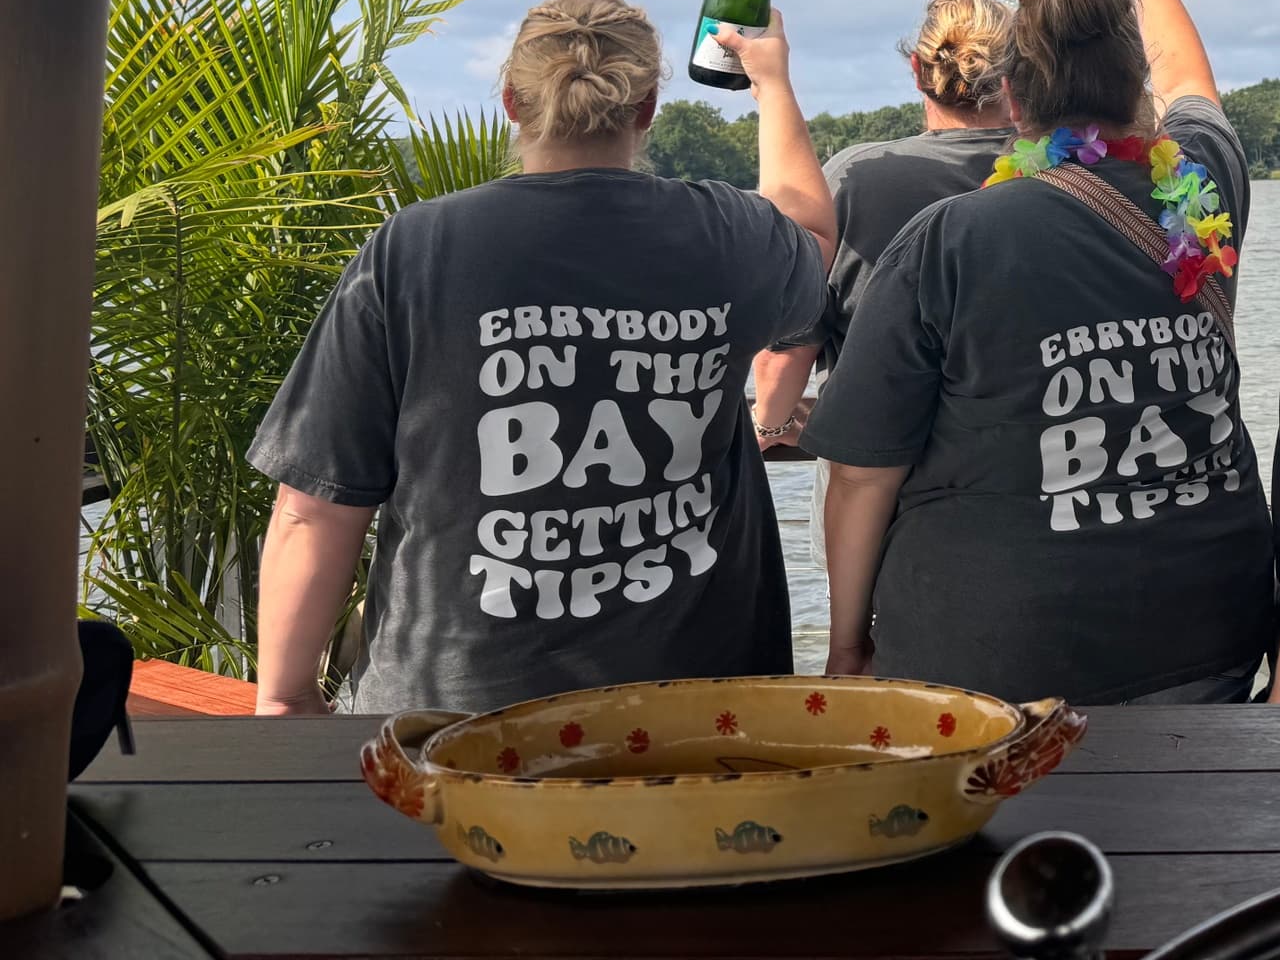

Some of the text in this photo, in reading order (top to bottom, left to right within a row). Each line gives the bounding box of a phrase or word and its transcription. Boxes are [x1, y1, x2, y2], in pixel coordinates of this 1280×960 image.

[479, 302, 732, 347] ERRYBODY
[1040, 311, 1217, 368] ERRYBOD
[479, 343, 731, 397] ON THE
[1042, 358, 1135, 417] ON
[477, 389, 724, 497] BAY
[1040, 370, 1234, 493] BAY
[477, 473, 712, 561] GETTIN
[469, 506, 719, 619] TIPSY
